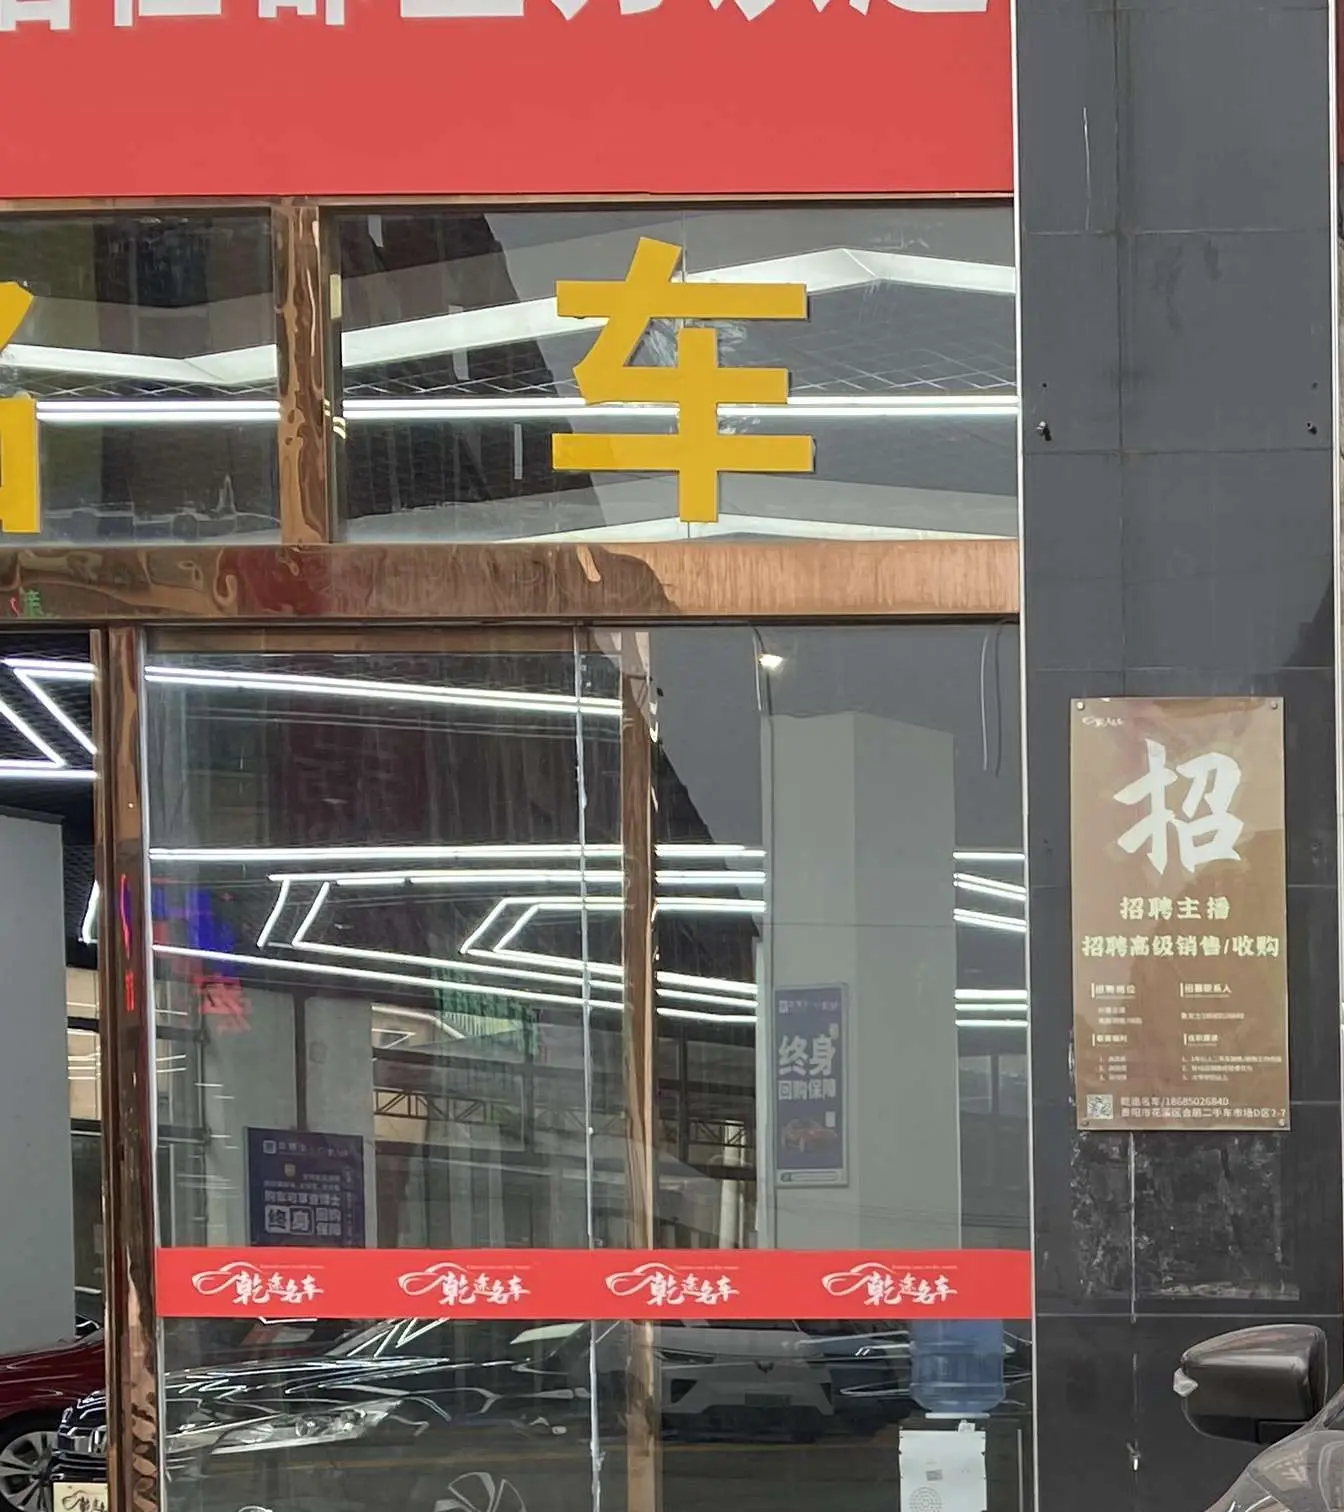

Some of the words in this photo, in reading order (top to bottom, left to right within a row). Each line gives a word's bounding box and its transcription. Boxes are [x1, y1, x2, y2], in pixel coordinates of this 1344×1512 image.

[551, 235, 816, 523] 车
[1112, 737, 1244, 875] 招
[1119, 896, 1231, 921] 招聘主播
[1081, 935, 1280, 958] 招聘高级销售/收购
[777, 1033, 836, 1076] 终身
[777, 1078, 837, 1100] 回购保障
